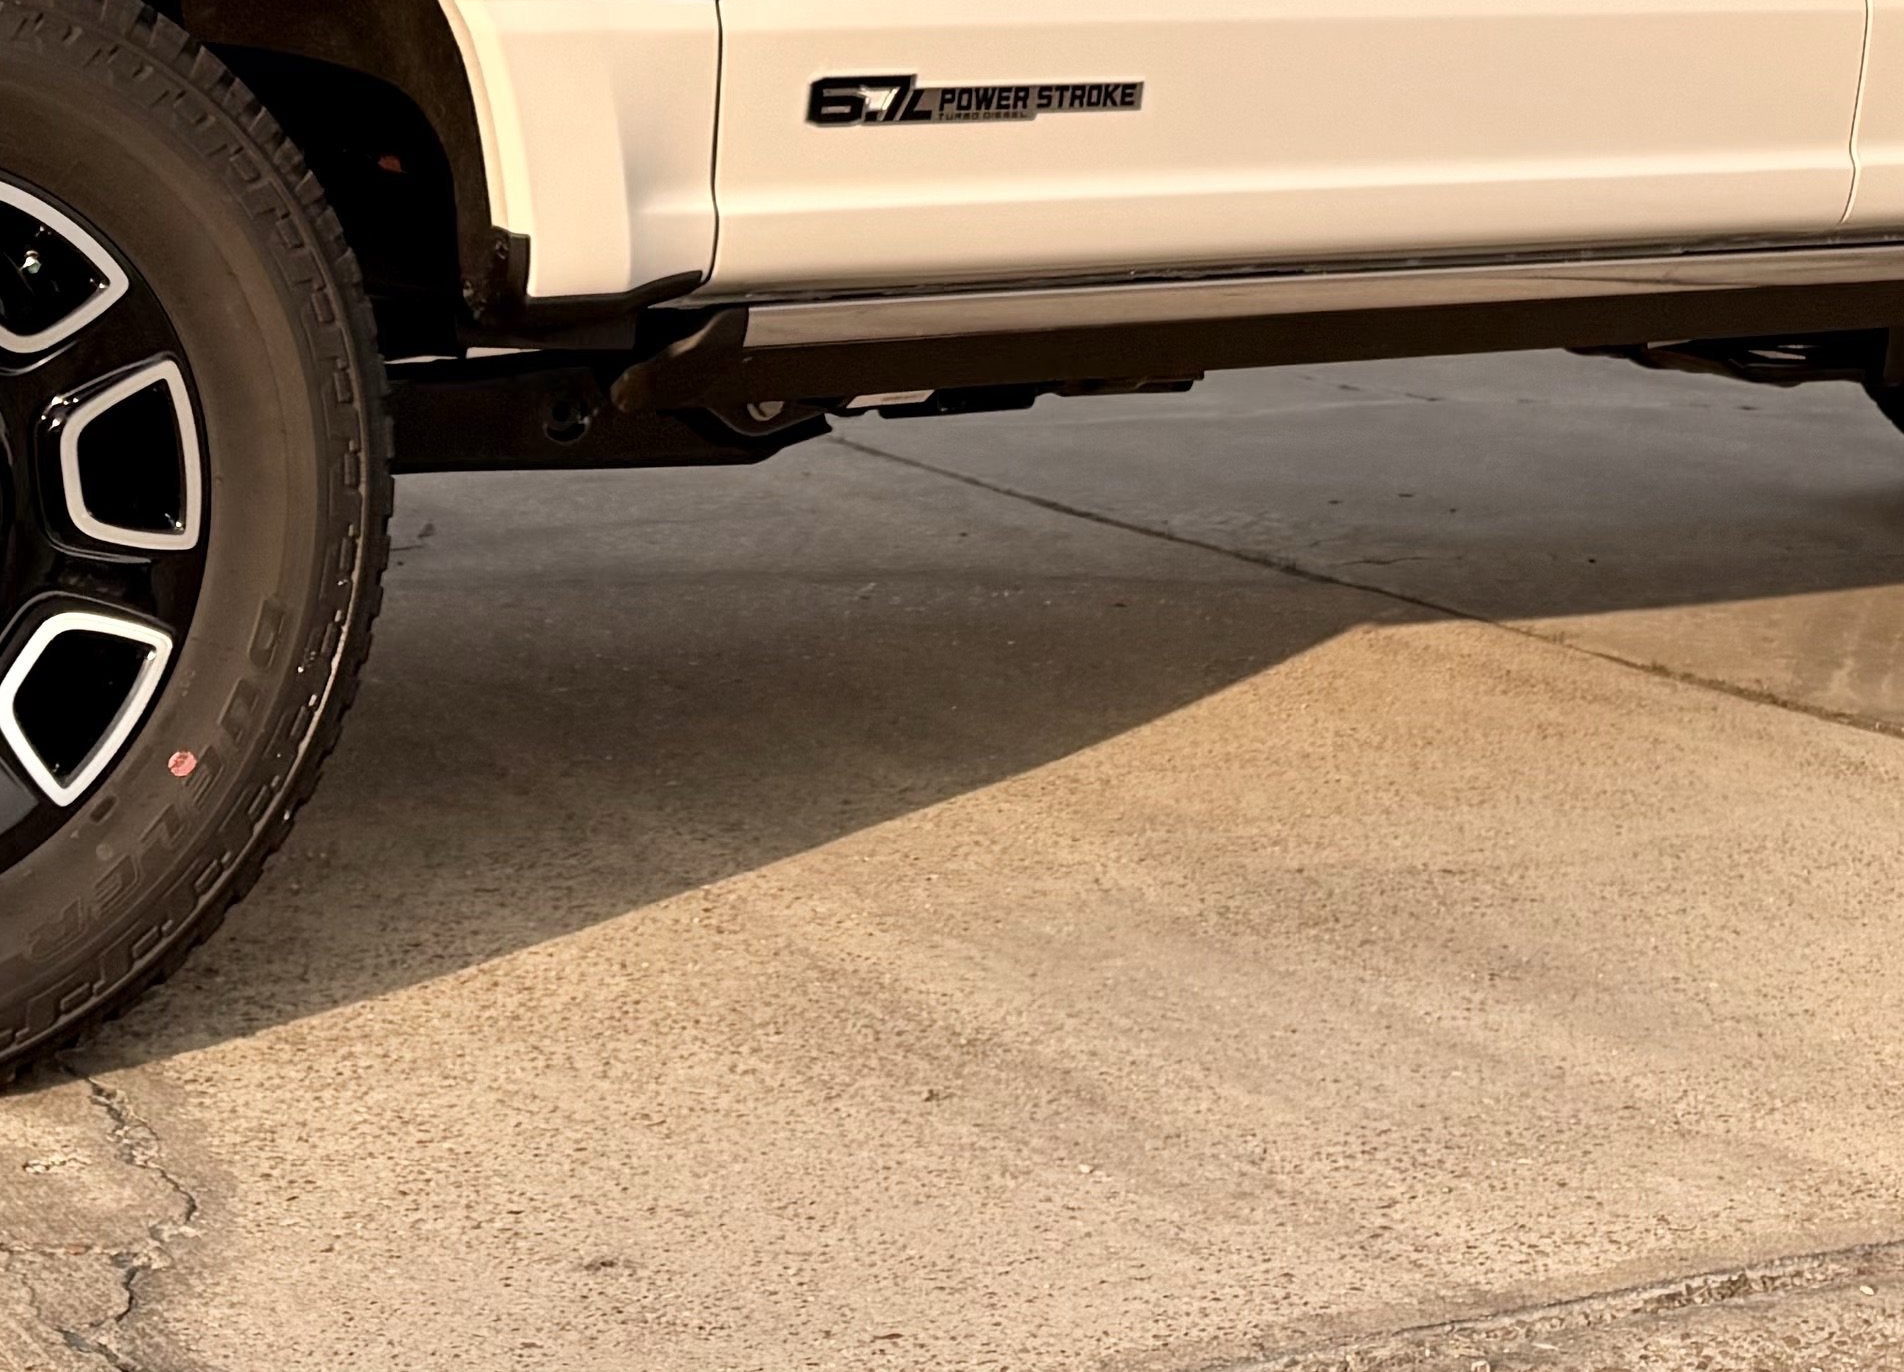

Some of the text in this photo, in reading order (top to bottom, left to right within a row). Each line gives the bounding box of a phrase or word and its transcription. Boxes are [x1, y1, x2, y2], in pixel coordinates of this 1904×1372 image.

[806, 73, 1137, 126] 6.7L POWER STROKE
[939, 111, 980, 122] TURBO
[24, 591, 288, 964] DUELER
